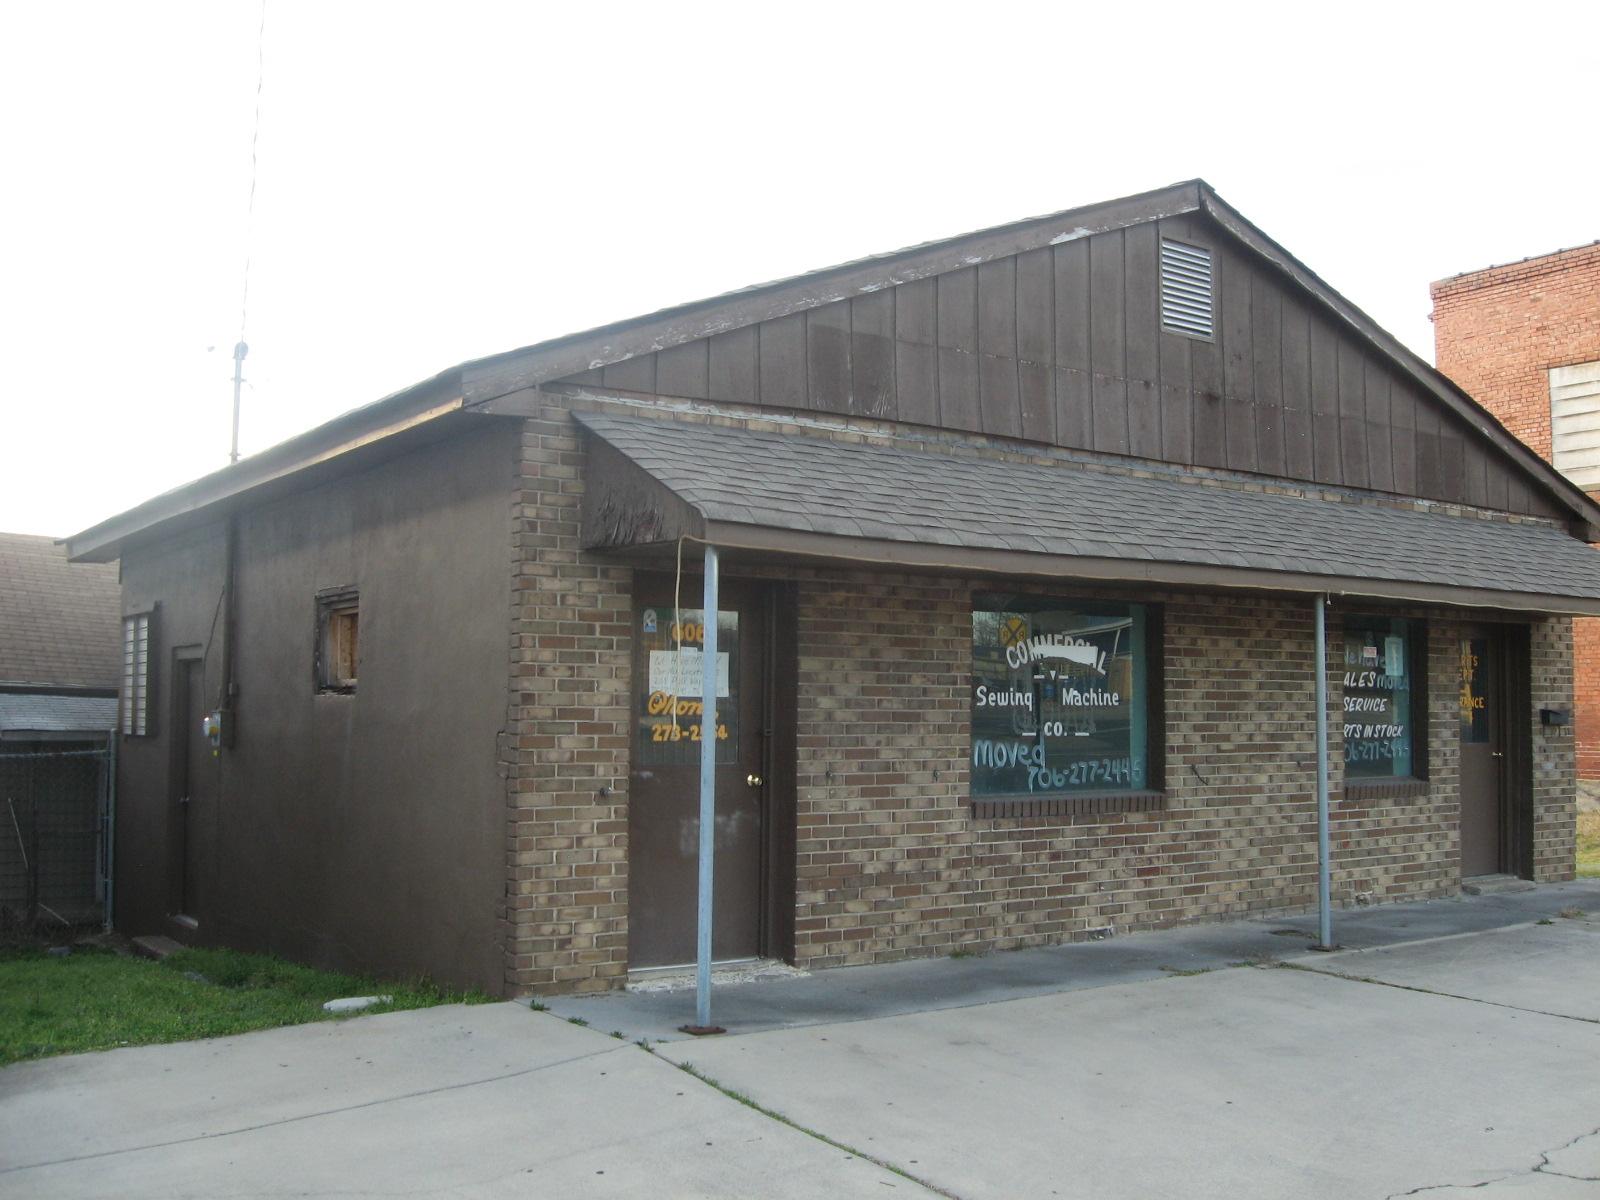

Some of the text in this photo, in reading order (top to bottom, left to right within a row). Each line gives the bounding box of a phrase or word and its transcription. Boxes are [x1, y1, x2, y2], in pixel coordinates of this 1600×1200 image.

[1006, 634, 1106, 676] COMMERL
[648, 690, 720, 717] Phon
[976, 685, 1120, 712] Sewing Machine
[1343, 696, 1388, 712] SERVICE
[651, 723, 728, 742] 273-24
[1363, 724, 1373, 738] IN
[1374, 724, 1404, 738] STOCK
